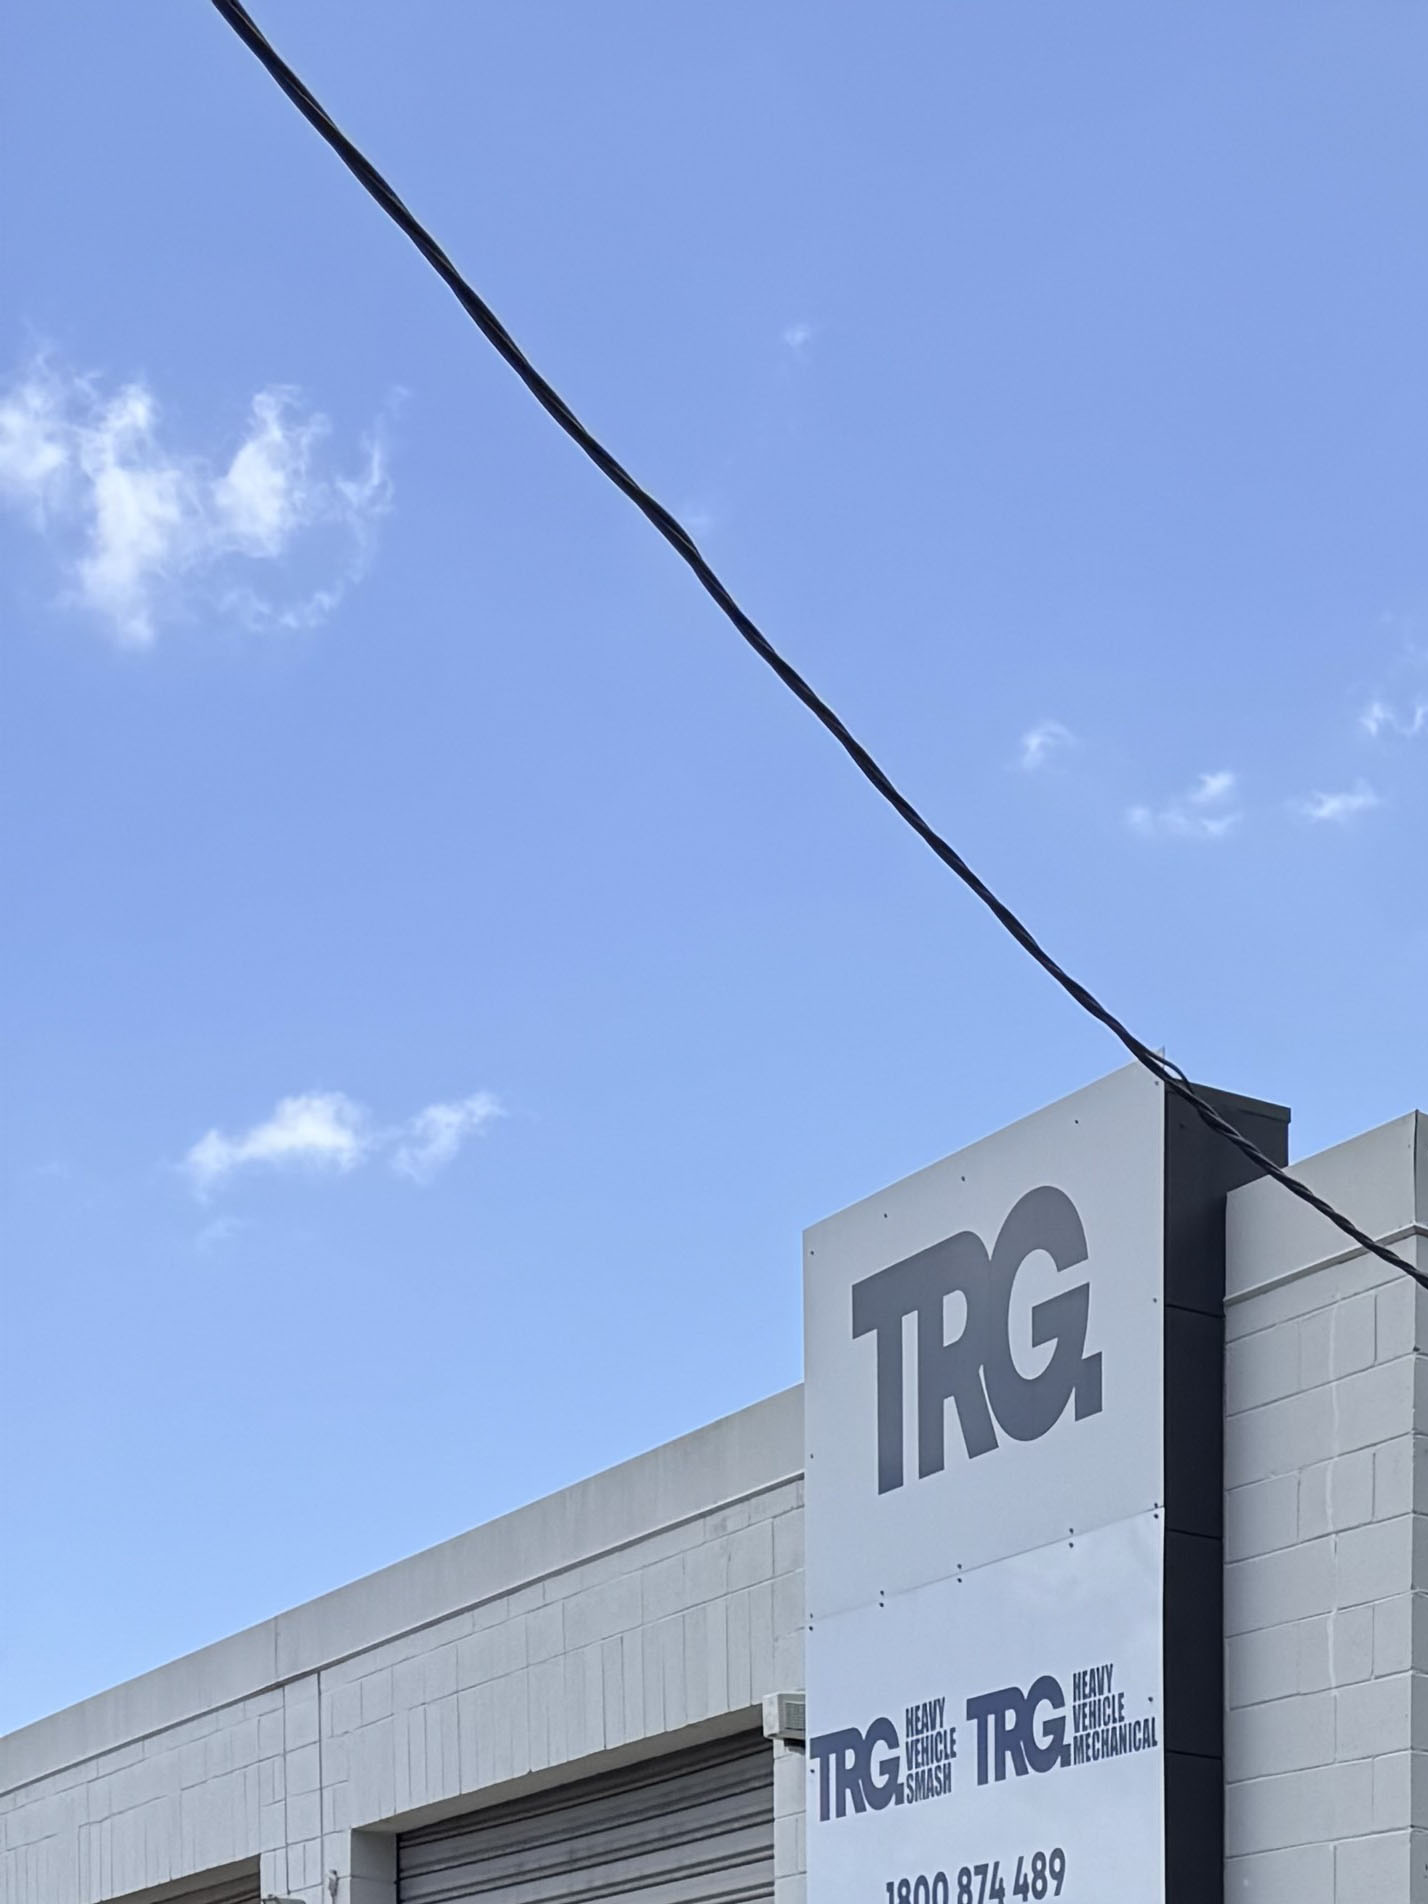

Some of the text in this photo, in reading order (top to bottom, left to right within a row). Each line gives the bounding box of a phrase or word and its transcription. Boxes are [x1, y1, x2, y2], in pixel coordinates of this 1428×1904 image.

[851, 1185, 1104, 1496] TRG
[1073, 1664, 1113, 1703] HEAVY
[905, 1697, 945, 1738] HEAVY
[966, 1675, 1072, 1785] TRG
[1073, 1692, 1125, 1731] VEHICLE
[905, 1727, 957, 1771] VEHICLE
[1073, 1717, 1158, 1765] MECHANICAL
[810, 1717, 904, 1822] TRG
[905, 1762, 952, 1804] SMASH
[1012, 1847, 1066, 1902] 489
